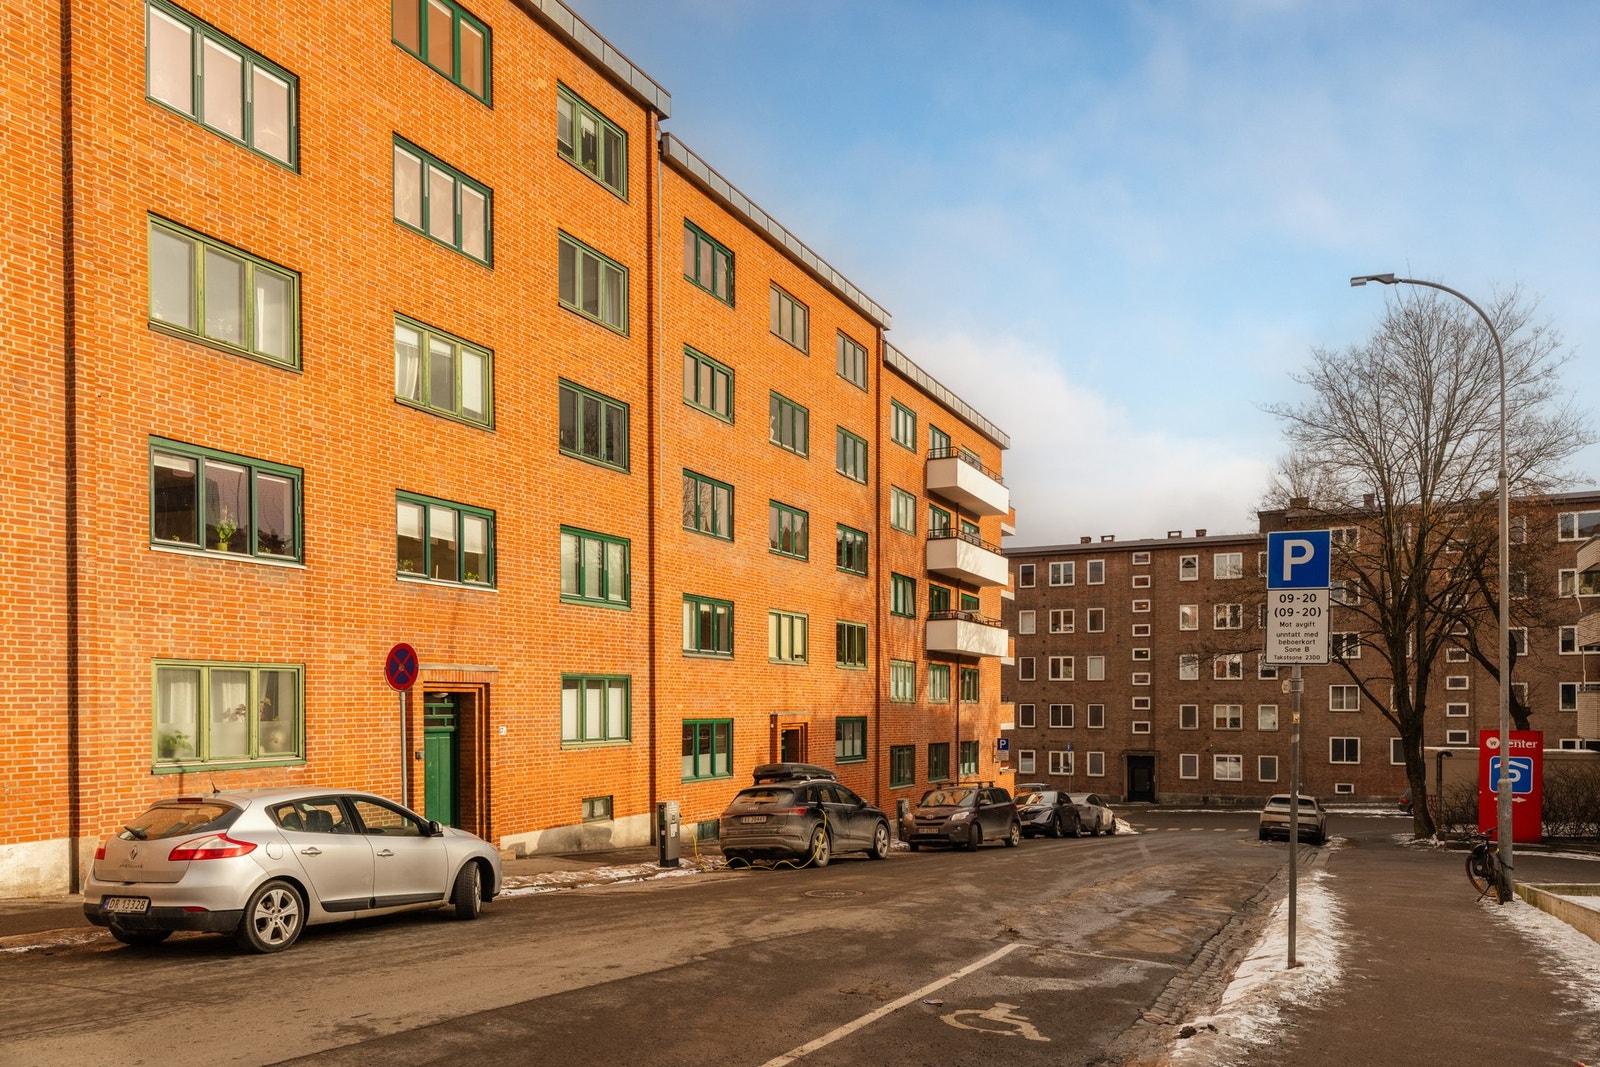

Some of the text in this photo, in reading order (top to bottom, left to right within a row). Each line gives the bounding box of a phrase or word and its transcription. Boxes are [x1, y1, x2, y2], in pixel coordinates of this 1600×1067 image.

[1283, 539, 1315, 581] P
[1295, 621, 1316, 629] avgift
[999, 740, 1007, 749] P
[1507, 739, 1538, 749] enter
[122, 899, 146, 911] 13328
